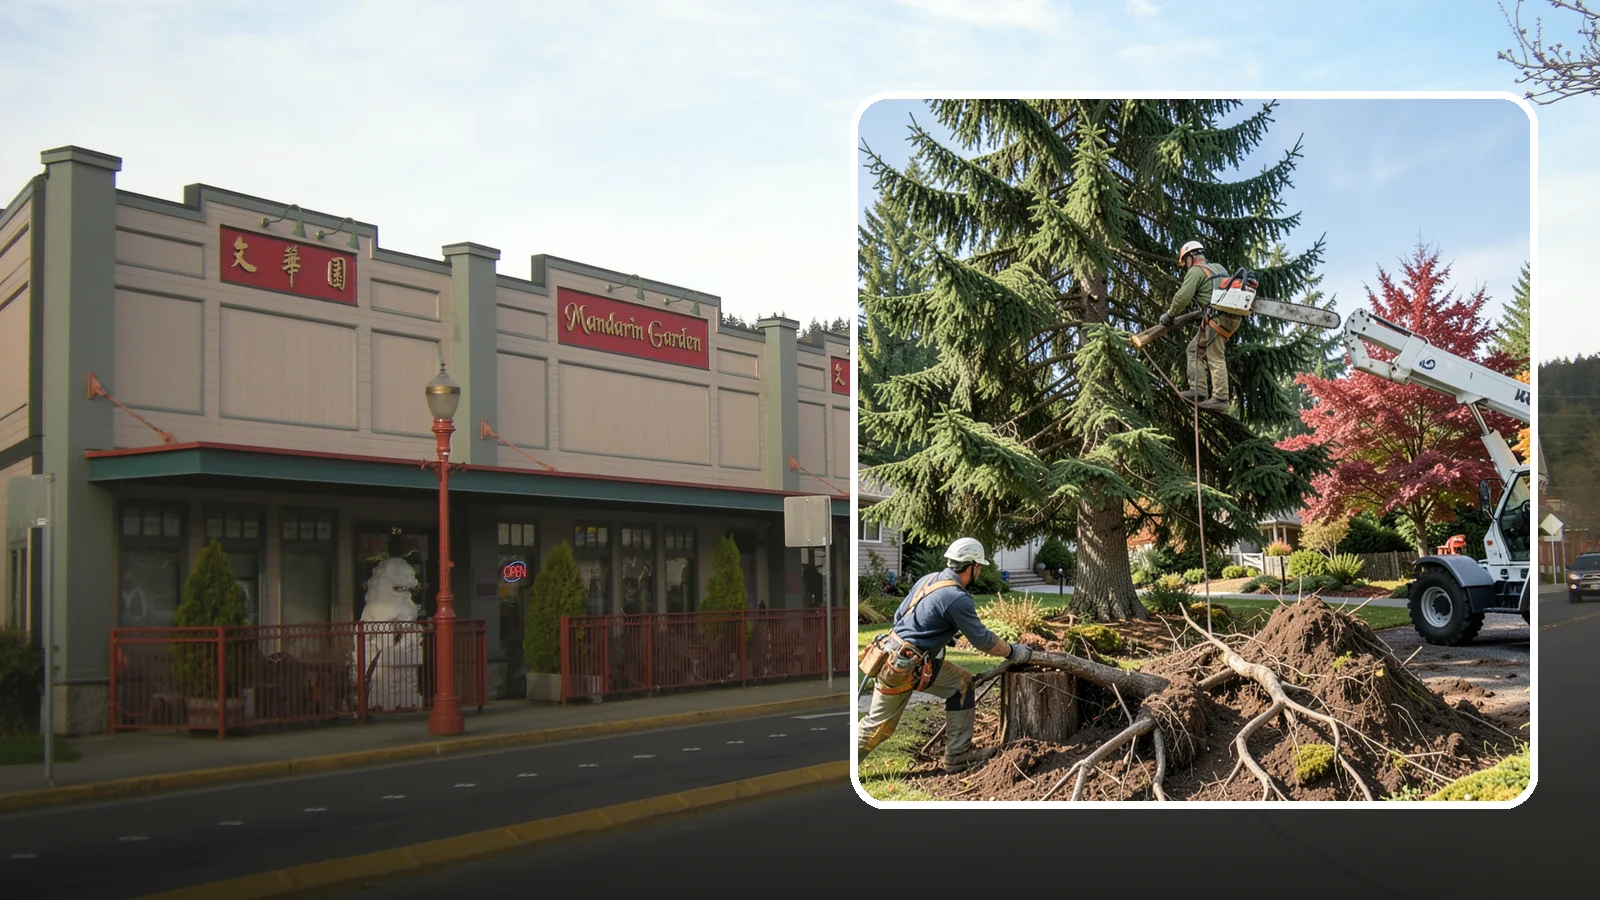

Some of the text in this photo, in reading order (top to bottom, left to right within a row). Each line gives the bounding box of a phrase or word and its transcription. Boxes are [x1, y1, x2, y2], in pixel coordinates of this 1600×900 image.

[231, 235, 346, 290] 文華園
[564, 302, 702, 352] Mandarin Garden
[503, 565, 527, 578] OPEN
